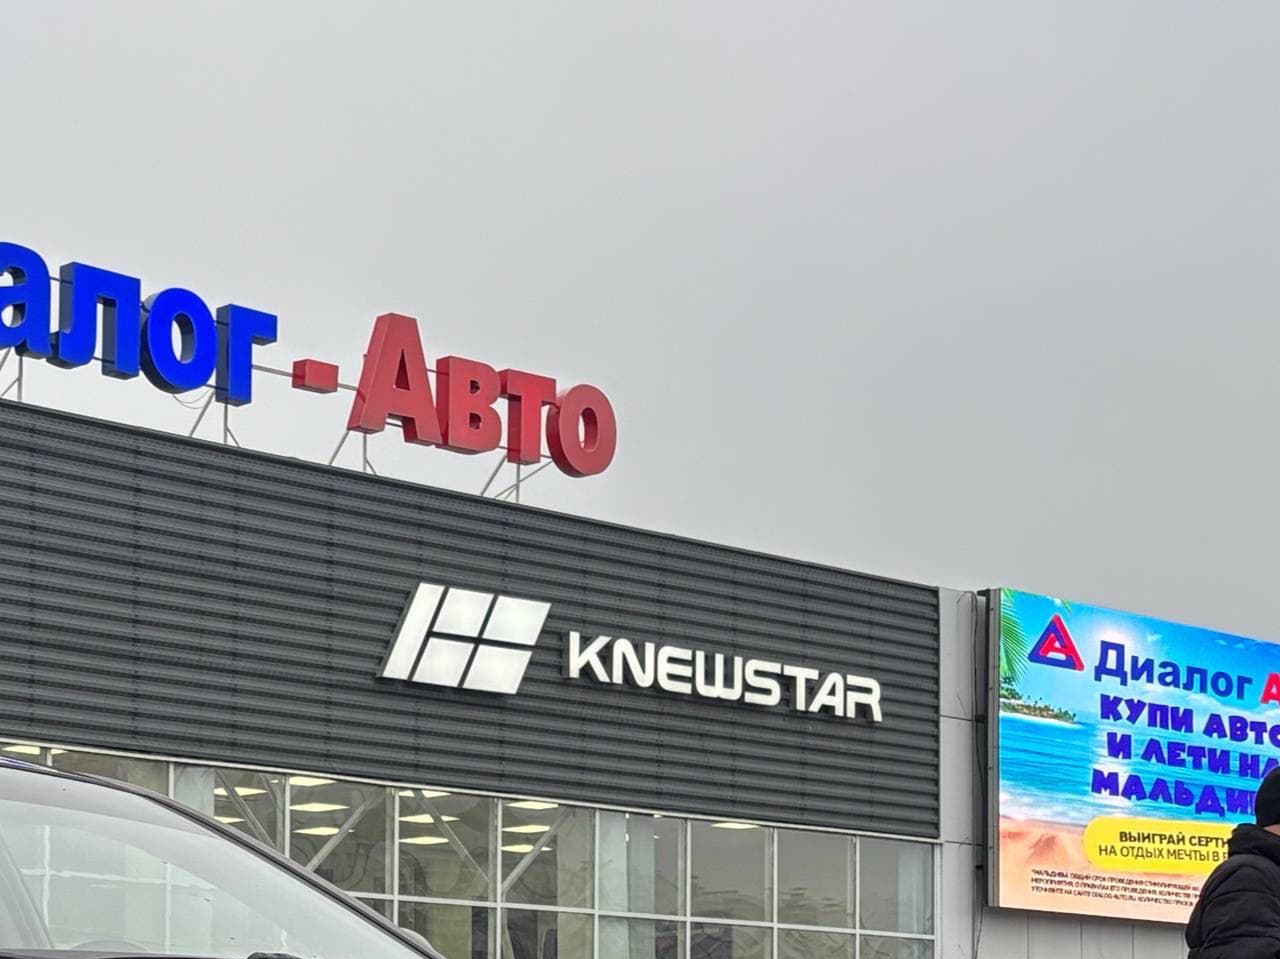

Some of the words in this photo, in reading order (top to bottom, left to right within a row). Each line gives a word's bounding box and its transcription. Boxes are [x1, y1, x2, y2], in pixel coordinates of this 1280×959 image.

[568, 630, 883, 722] KNEWSTAR
[1094, 640, 1253, 700] Диалог
[1100, 694, 1194, 733] КУПИ
[1107, 732, 1132, 760] И
[1140, 738, 1230, 774] ЛЕТИ
[1098, 845, 1117, 856] НА
[1120, 846, 1165, 860] ОТДЫХ
[1166, 848, 1210, 861] МЕЧТЫ
[1212, 851, 1220, 862] В
[1119, 830, 1186, 846] ВЫИГРАЙ
